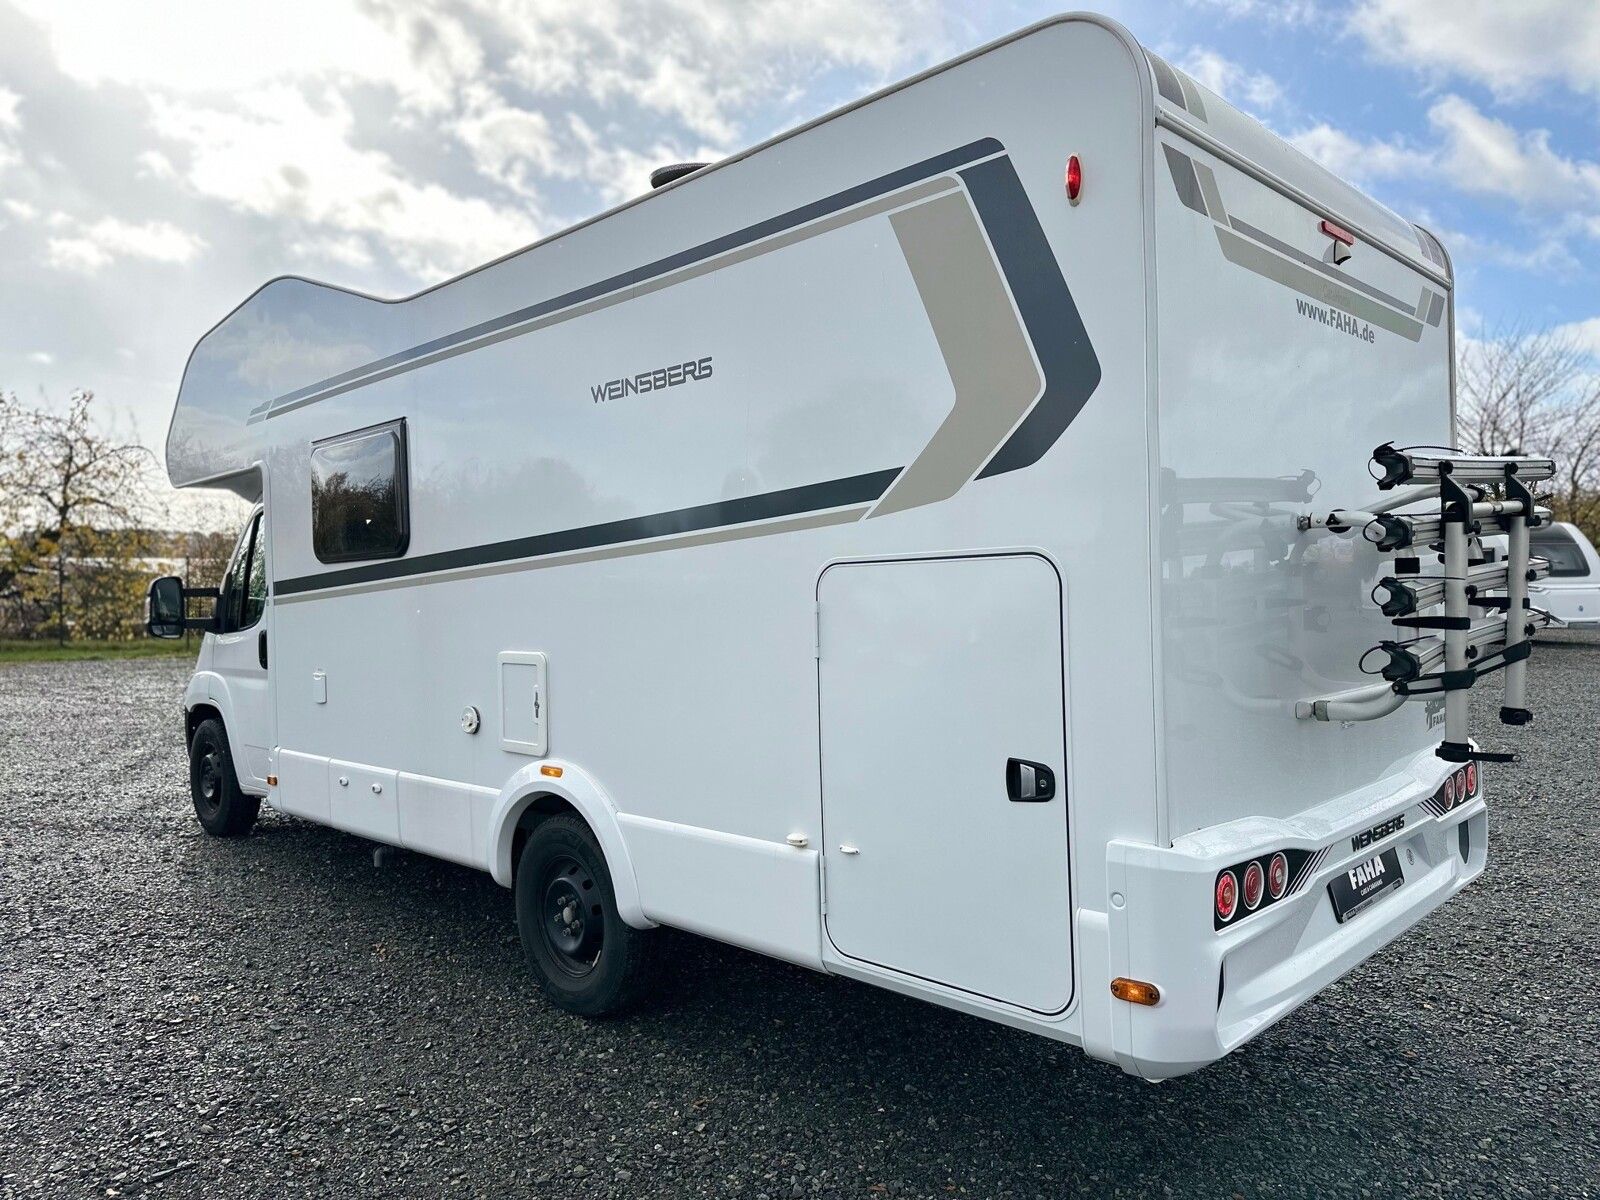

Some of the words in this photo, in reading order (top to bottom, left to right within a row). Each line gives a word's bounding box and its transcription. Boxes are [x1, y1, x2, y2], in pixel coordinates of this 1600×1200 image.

[1296, 298, 1375, 344] www.FAHA.de
[591, 356, 713, 404] WEINSBERG
[1351, 813, 1405, 852] WEINSBERG
[1347, 854, 1386, 891] FAHA
